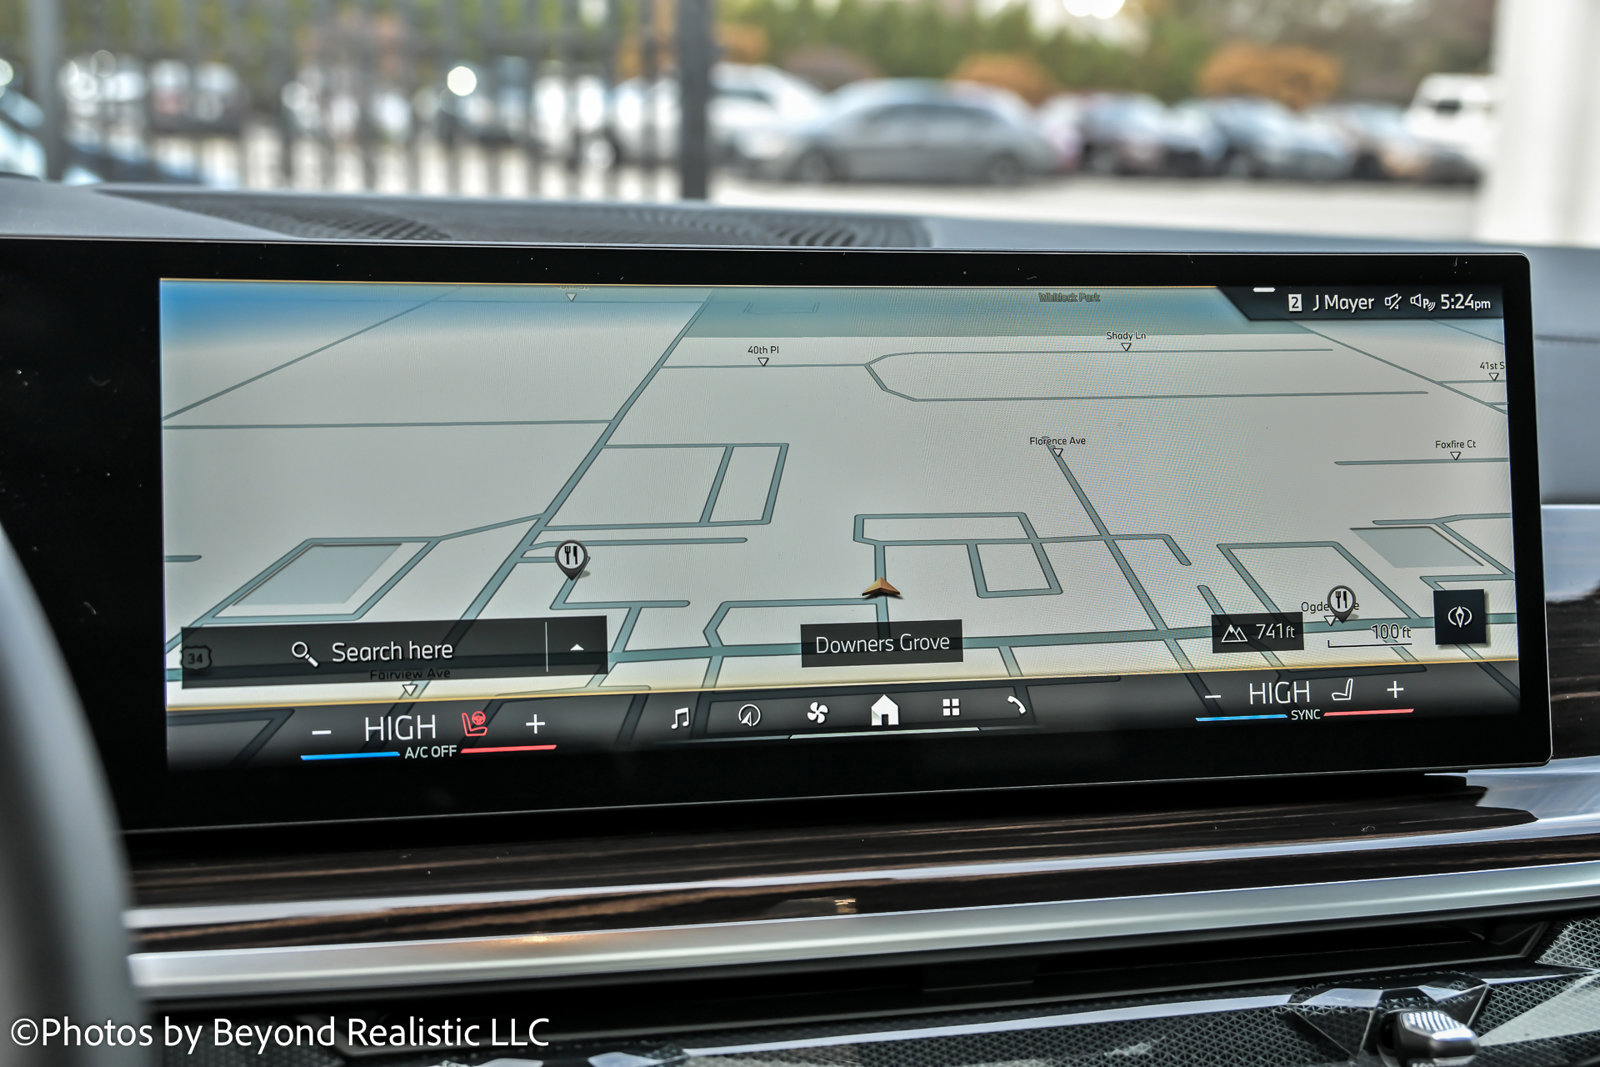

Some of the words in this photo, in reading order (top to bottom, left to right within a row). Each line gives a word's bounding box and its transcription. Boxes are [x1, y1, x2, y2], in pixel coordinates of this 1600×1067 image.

[1290, 296, 1300, 309] 2
[1312, 294, 1320, 312] J
[1324, 294, 1374, 313] Mayer
[1106, 331, 1134, 341] Shady
[1135, 331, 1146, 340] Ln
[747, 345, 768, 354] 40th
[1479, 361, 1498, 370] 41st
[1029, 436, 1068, 446] Florence
[1069, 436, 1087, 445] Ave
[1435, 440, 1465, 449] Foxfire
[1466, 439, 1477, 449] Ct
[1372, 624, 1400, 640] 100
[815, 635, 895, 654] Downers
[899, 633, 951, 651] Grove
[187, 653, 204, 665] 34
[332, 642, 402, 663] Search
[408, 641, 454, 661] here
[370, 669, 424, 681] Fairview
[426, 667, 451, 679] Ave
[1249, 681, 1310, 705] HIGH
[1290, 708, 1321, 722] SYNC
[364, 714, 437, 741] HIGH
[404, 747, 429, 760] A/C
[431, 745, 458, 759] OFF
